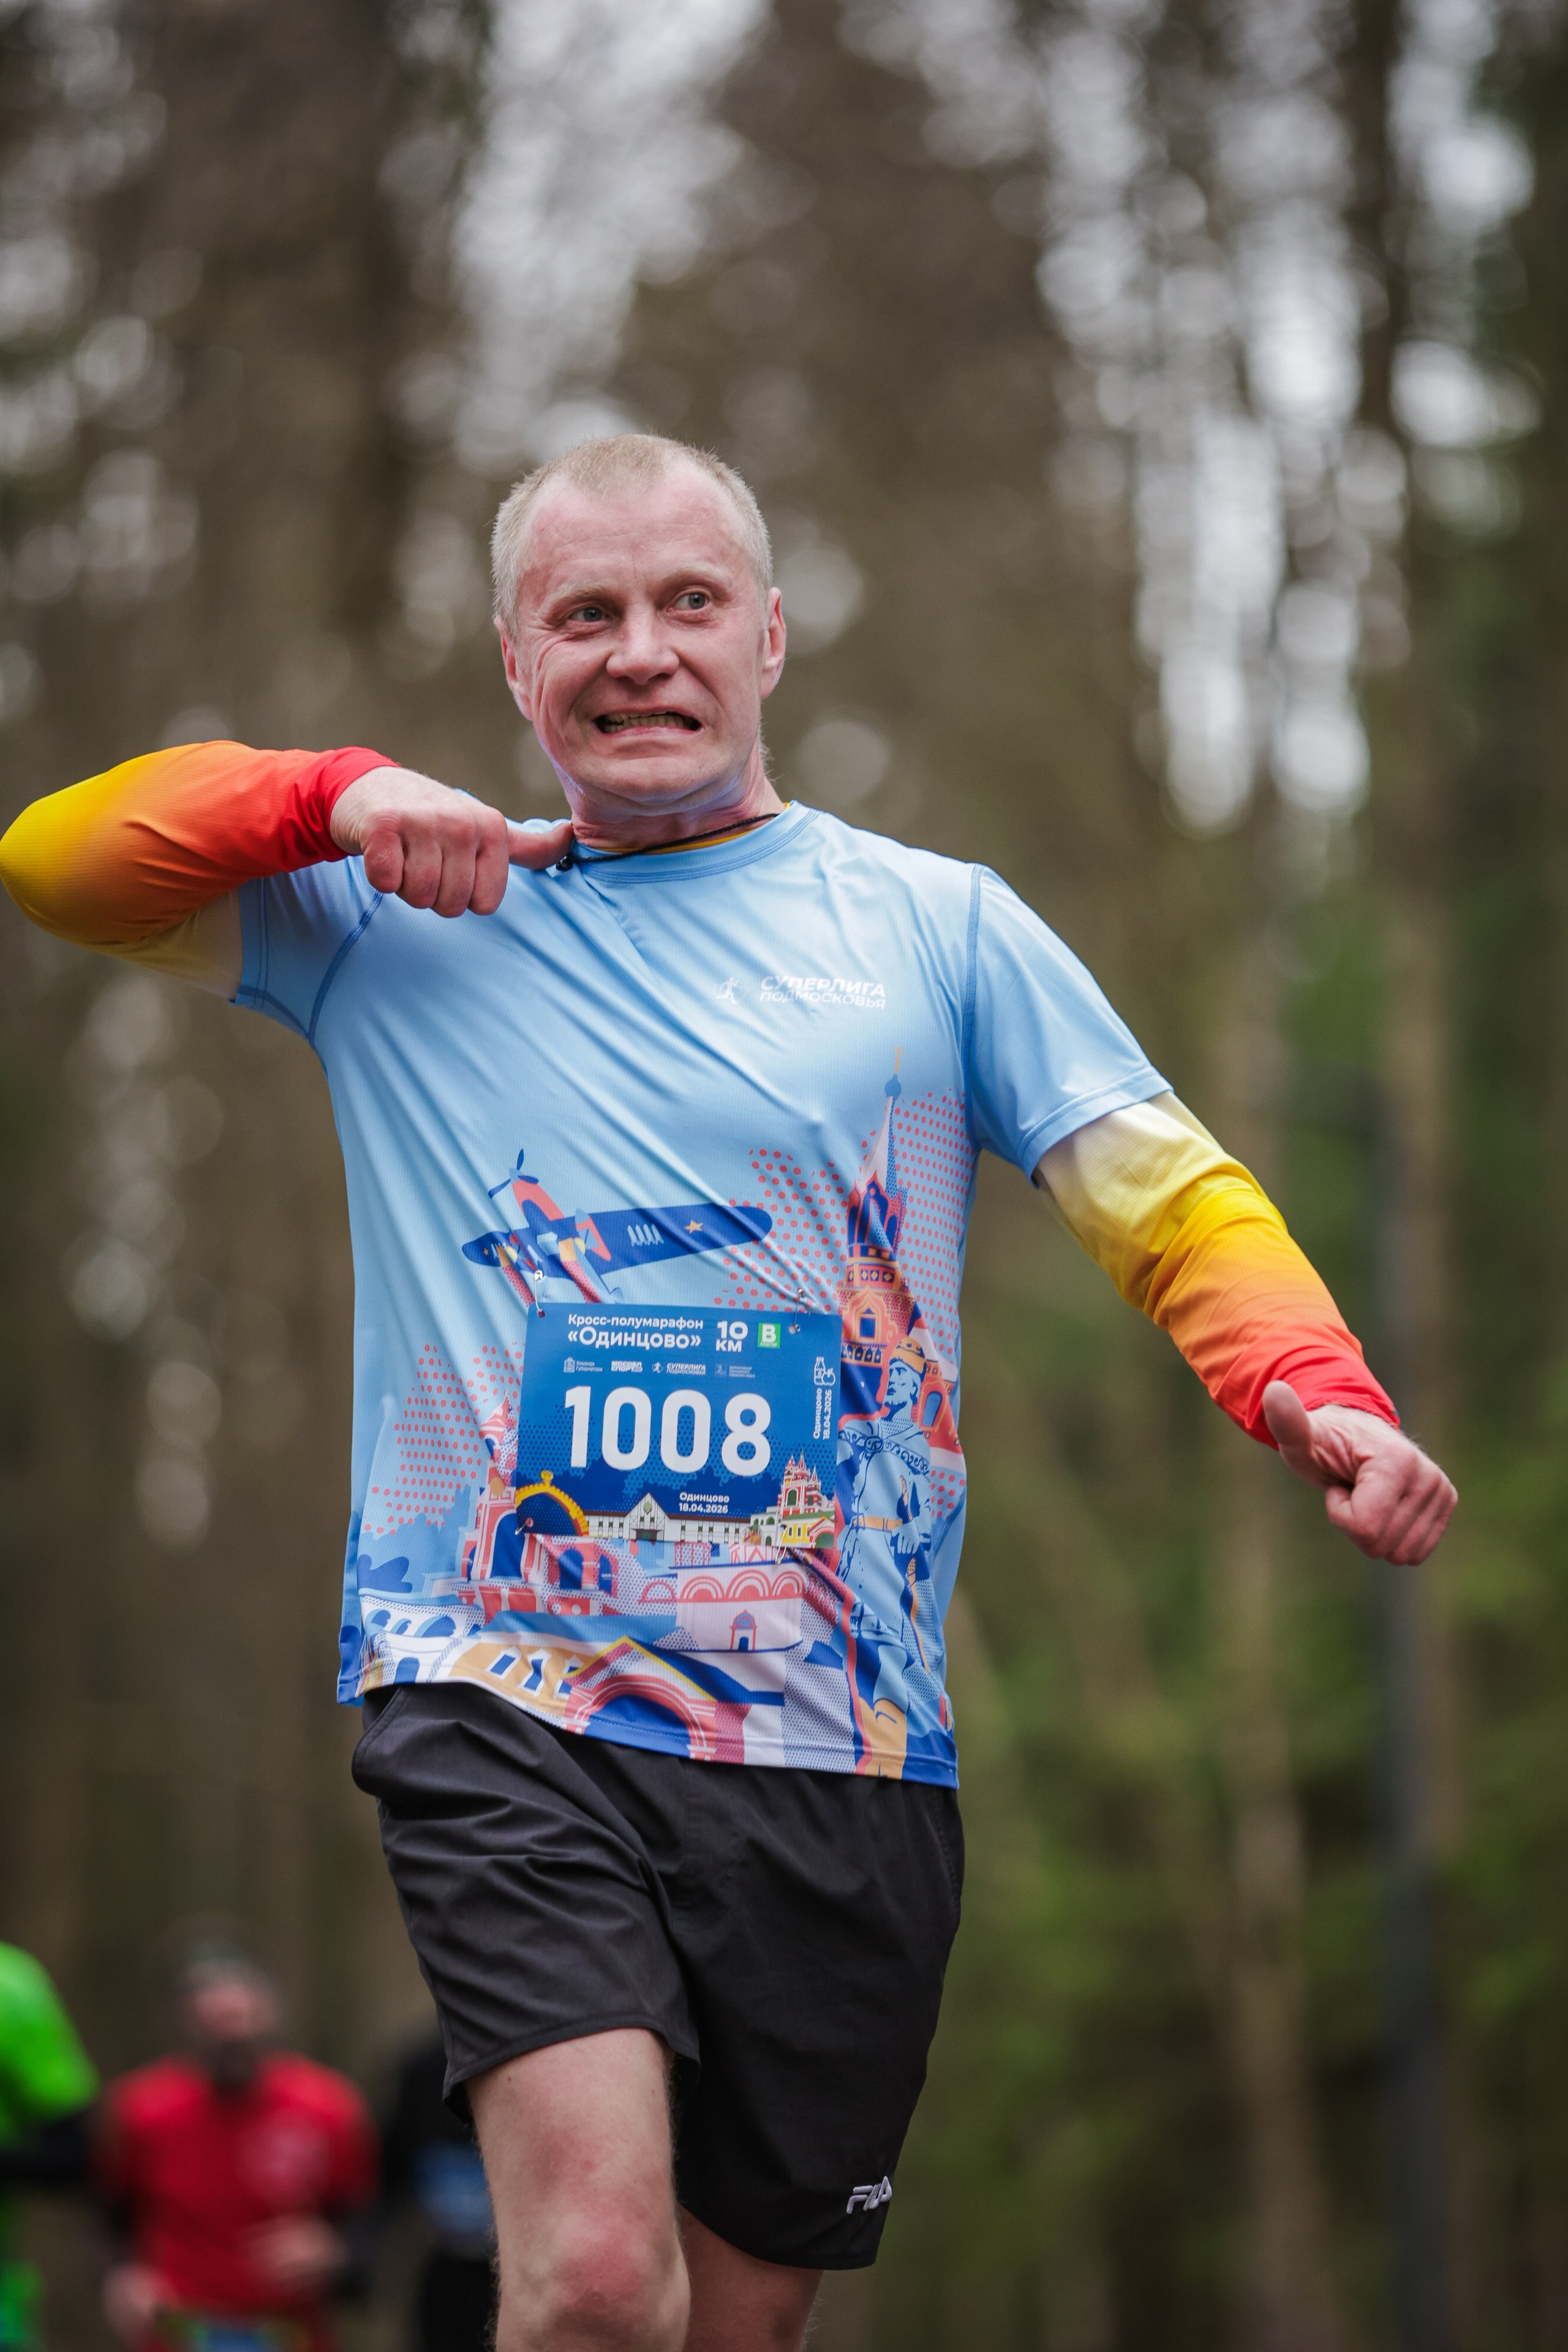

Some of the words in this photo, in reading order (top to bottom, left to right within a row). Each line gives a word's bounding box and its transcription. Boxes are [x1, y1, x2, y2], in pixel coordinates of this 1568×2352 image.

[760, 975, 886, 998] СУПЕРЛИГА
[760, 991, 886, 1010] ПОДМОСКОВЬЯ
[568, 1313, 704, 1331] Кросс-полумарафон
[717, 1320, 748, 1340] 10
[568, 1326, 701, 1351] «Одинцово»
[813, 1387, 823, 1440] Одинцово
[823, 1389, 832, 1441] 18.04.2026
[564, 1385, 772, 1477] 1008
[679, 1491, 730, 1503] Одинцово
[679, 1502, 729, 1515] 18.04.2026
